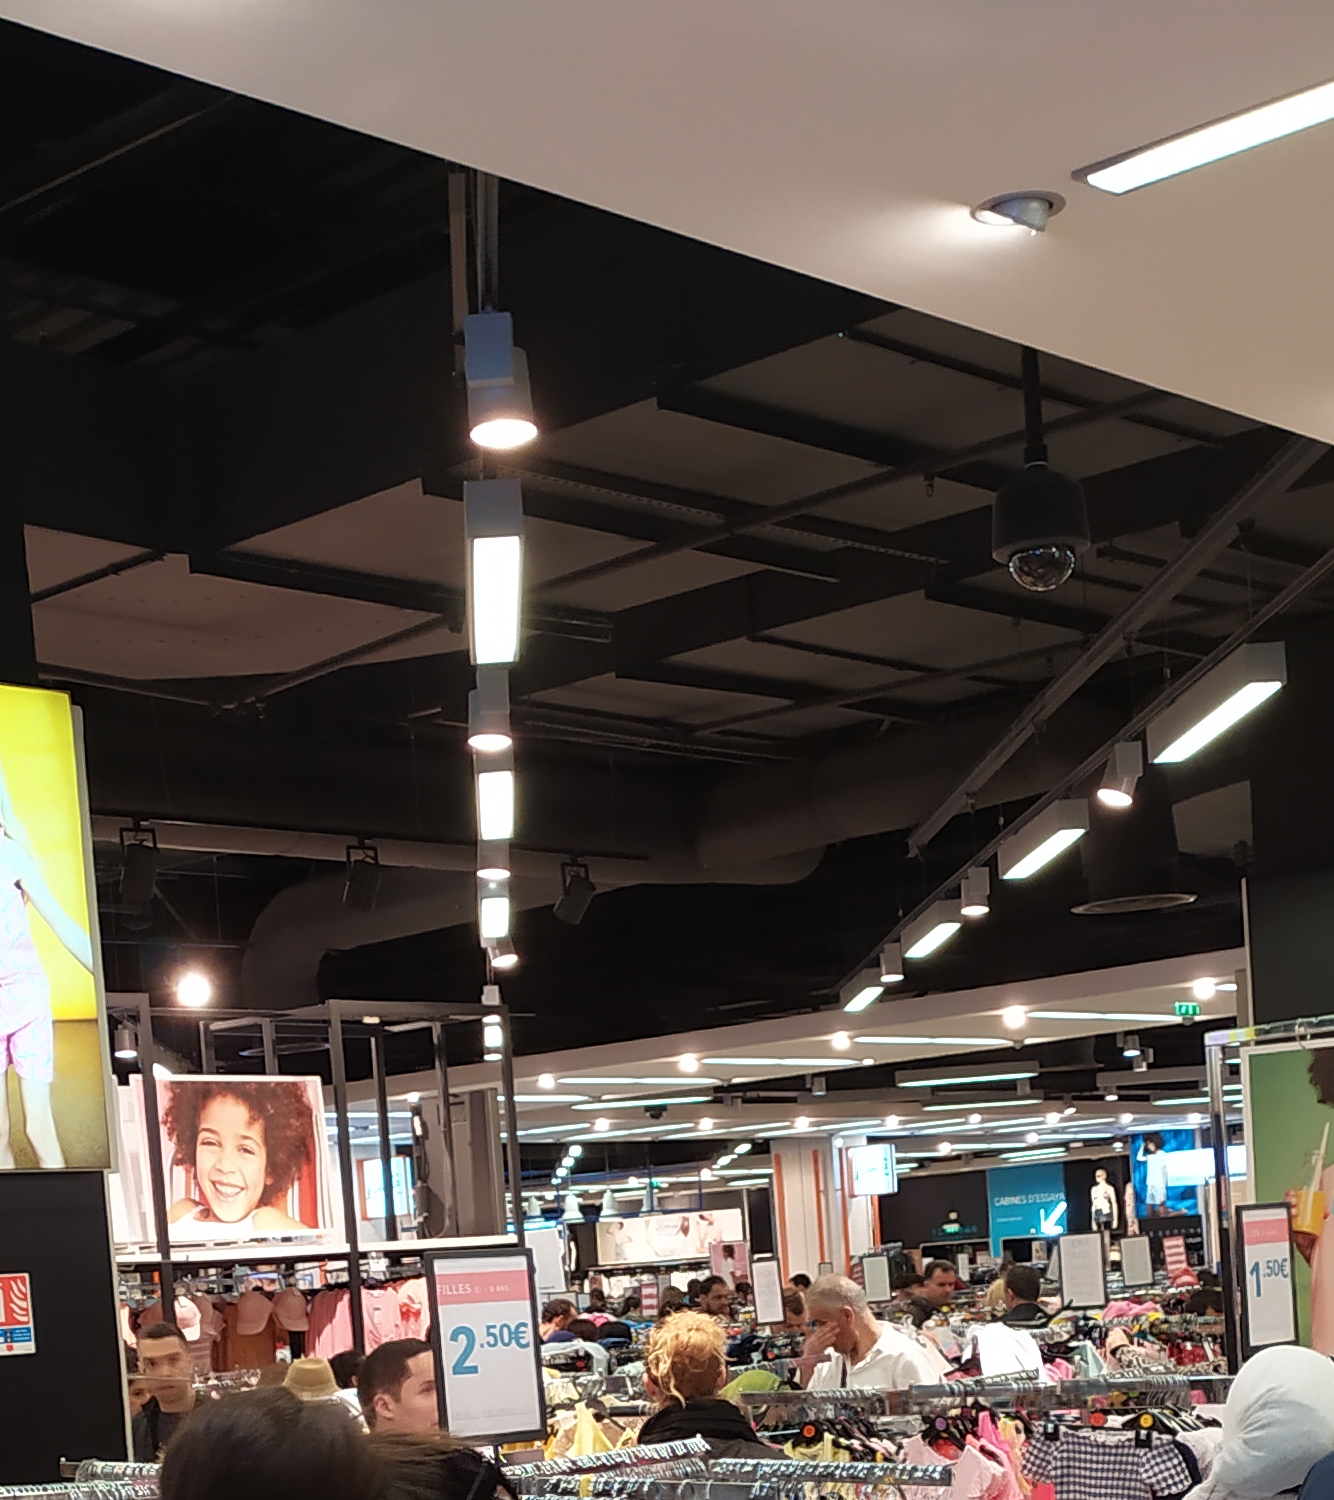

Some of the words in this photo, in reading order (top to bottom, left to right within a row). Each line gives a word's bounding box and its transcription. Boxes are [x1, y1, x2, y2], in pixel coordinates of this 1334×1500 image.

[437, 1283, 472, 1296] FILLES
[1249, 1257, 1290, 1298] 1.50€
[449, 1321, 531, 1376] 2.50€
